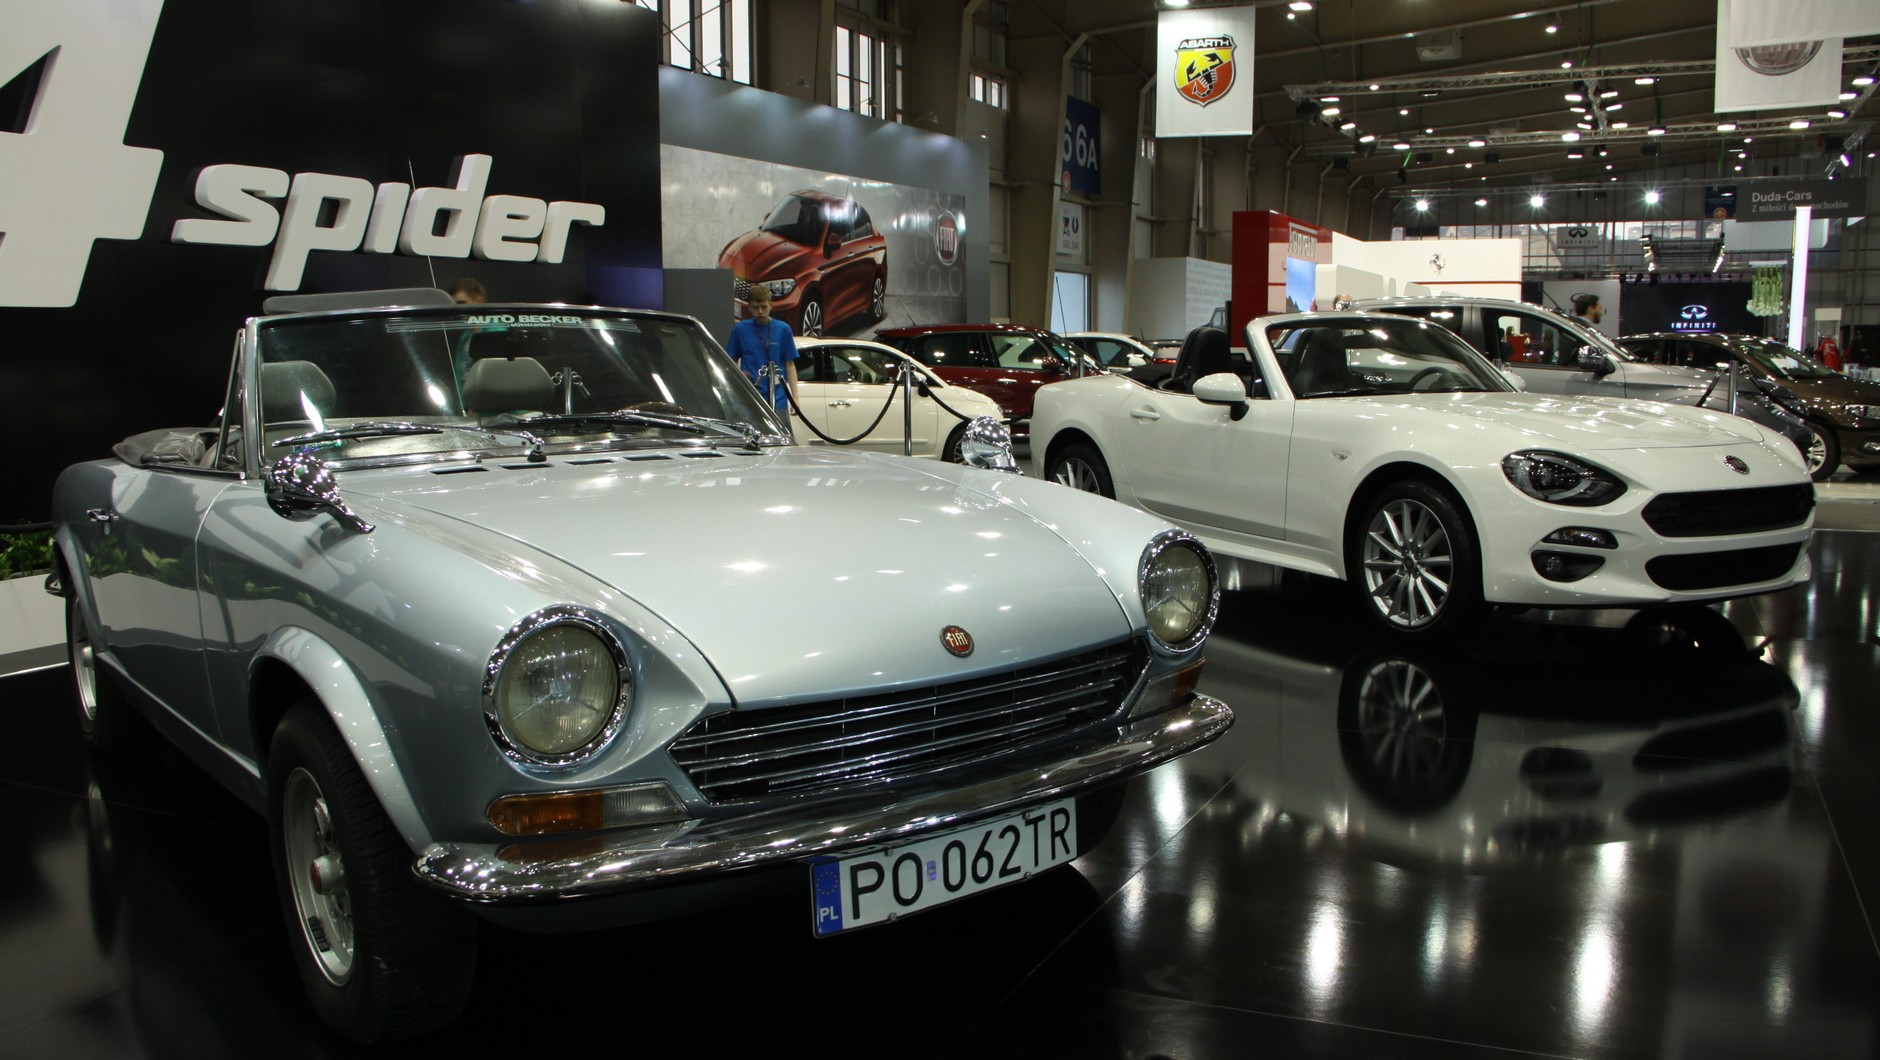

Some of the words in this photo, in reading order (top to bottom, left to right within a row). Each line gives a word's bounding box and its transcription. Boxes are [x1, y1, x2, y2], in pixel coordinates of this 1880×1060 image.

[1179, 39, 1230, 48] ABARTH
[1751, 190, 1813, 203] Duda-Cars
[1758, 203, 1786, 213] miłości
[171, 153, 606, 291] spider
[939, 226, 955, 252] FIAT
[467, 314, 515, 324] AUTO
[518, 314, 583, 324] BECKER
[945, 632, 969, 647] FIAT
[850, 851, 923, 920] PO
[942, 807, 1071, 893] 062TR
[819, 905, 839, 923] PL
